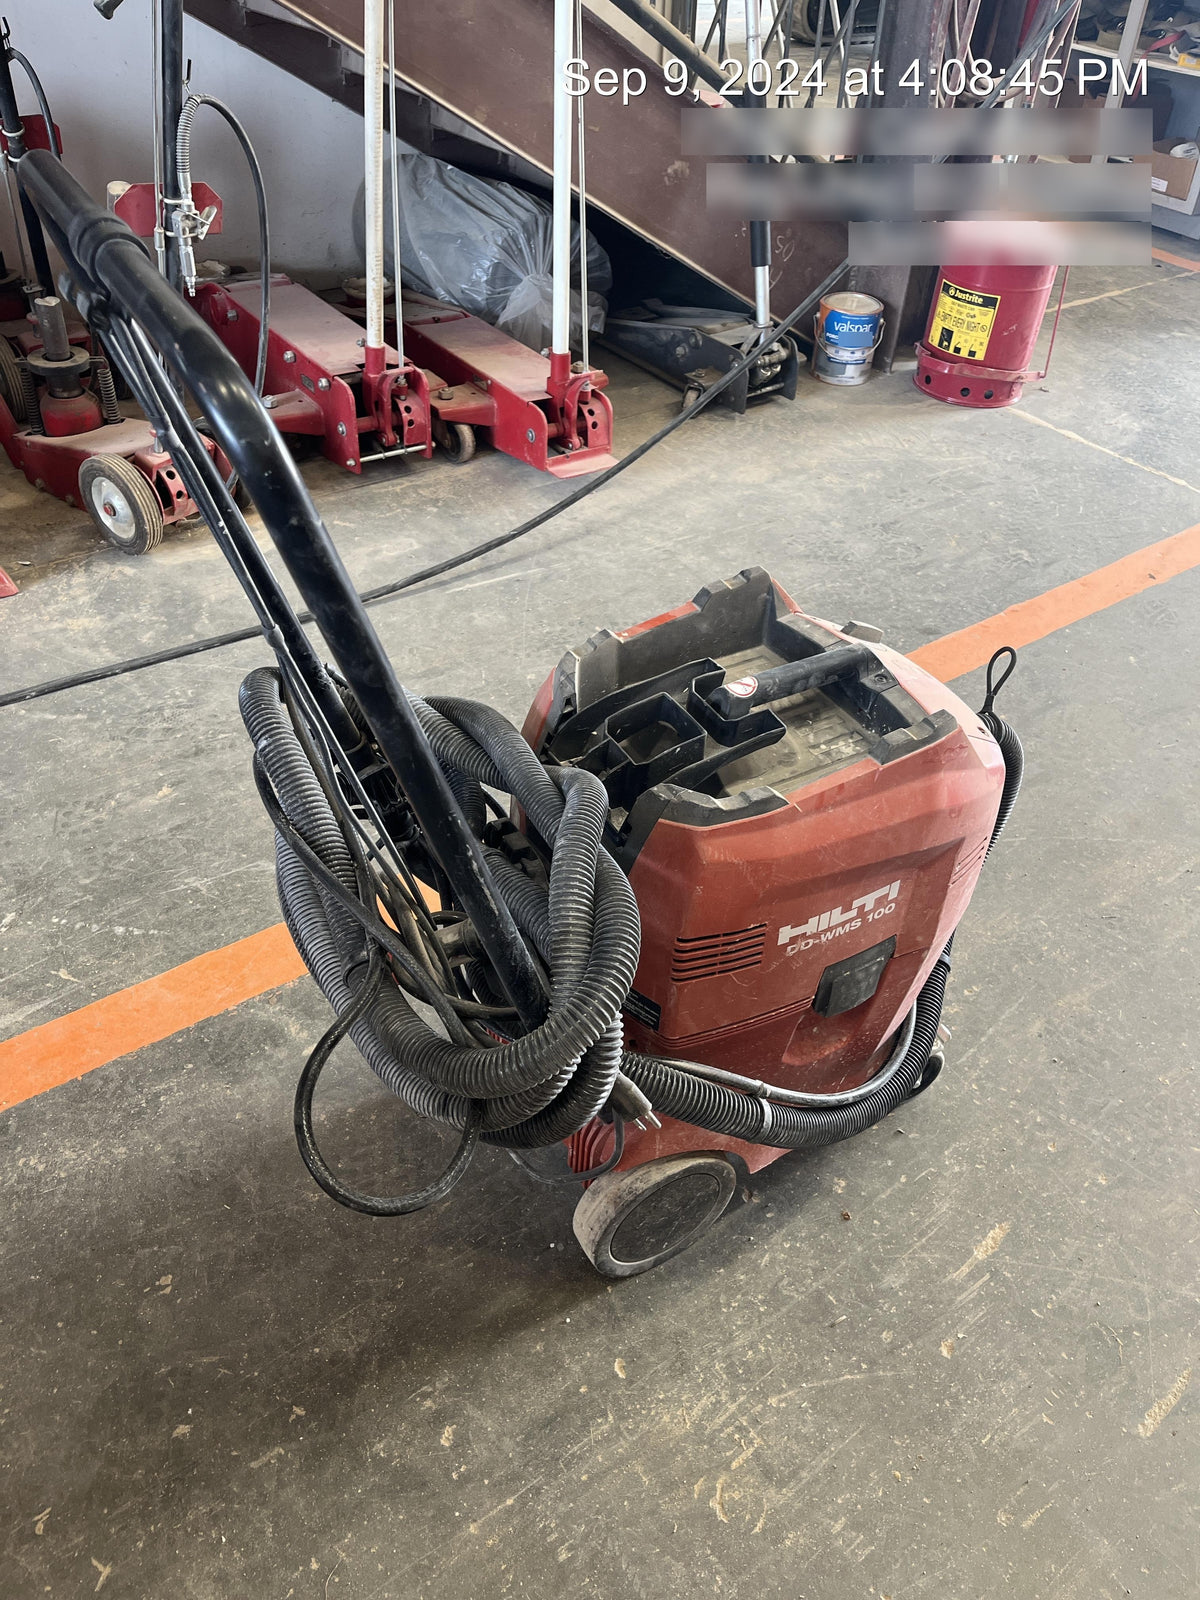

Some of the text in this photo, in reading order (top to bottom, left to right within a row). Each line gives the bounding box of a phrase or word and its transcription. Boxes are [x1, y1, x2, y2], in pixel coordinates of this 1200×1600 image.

[954, 290, 984, 304] Justrite
[834, 320, 873, 333] valspar
[952, 315, 966, 329] EVERY
[966, 320, 981, 332] NIGHT
[777, 880, 900, 946] HILTI
[786, 902, 896, 957] DD-WMS 100
